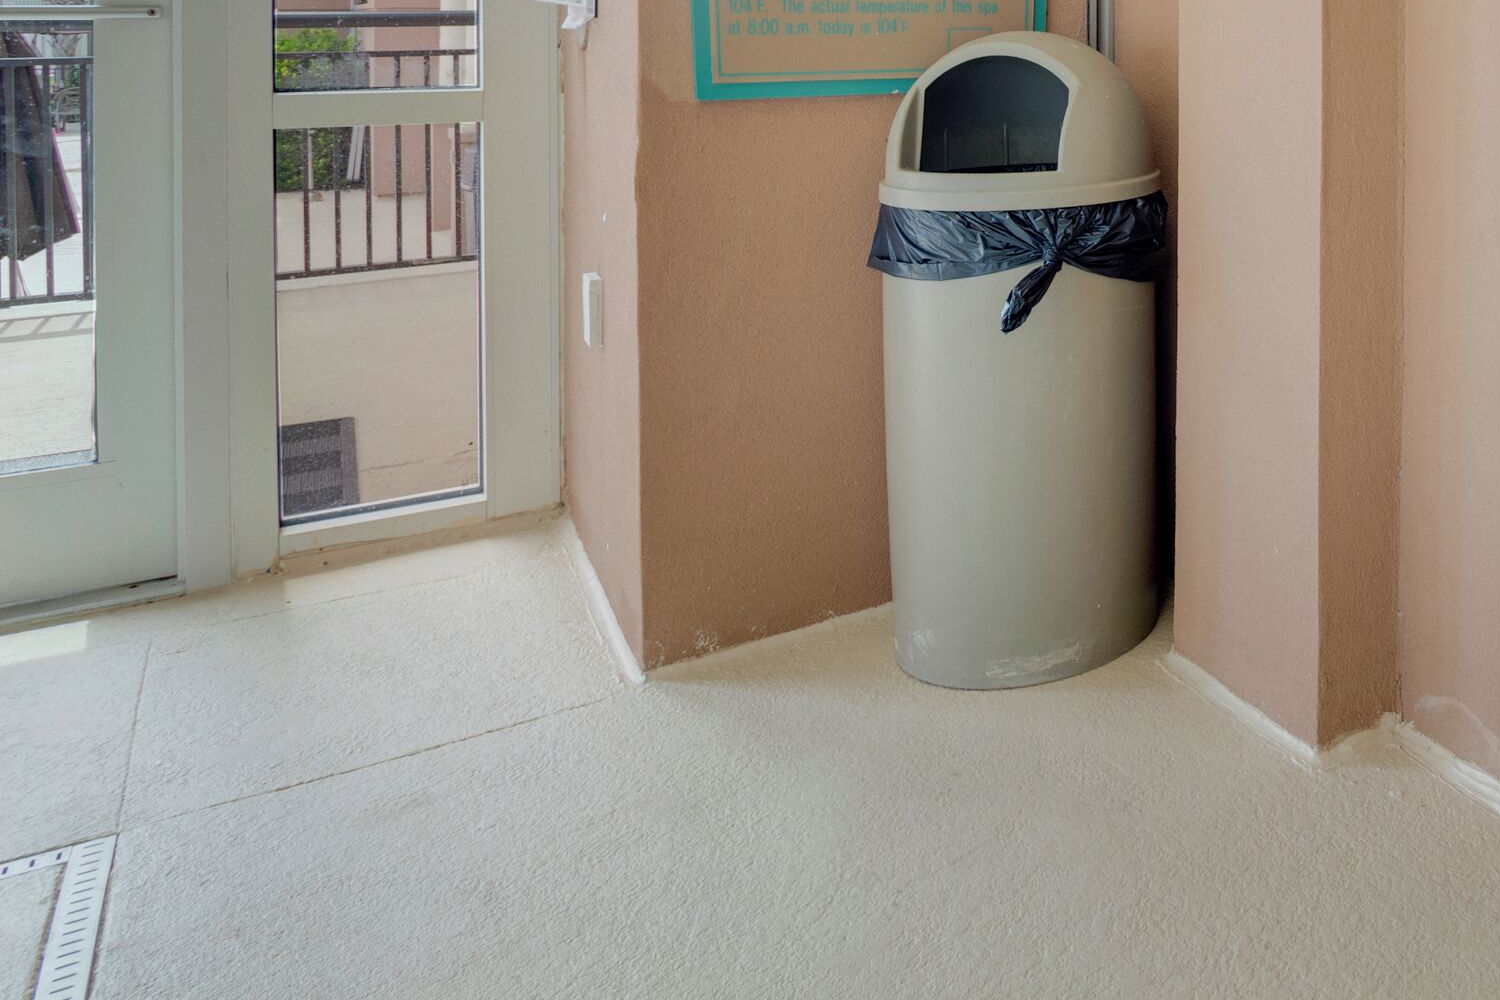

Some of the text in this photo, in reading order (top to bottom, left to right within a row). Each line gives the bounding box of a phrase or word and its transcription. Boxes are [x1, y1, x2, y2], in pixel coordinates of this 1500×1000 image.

[781, 0, 804, 13] The
[811, 0, 850, 13] actual
[856, 1, 928, 16] temperature
[935, 2, 946, 14] of
[953, 2, 972, 14] this
[978, 5, 998, 17] spa
[727, 22, 741, 34] at
[748, 22, 781, 34] 8:00
[816, 22, 856, 37] today
[860, 22, 872, 34] is
